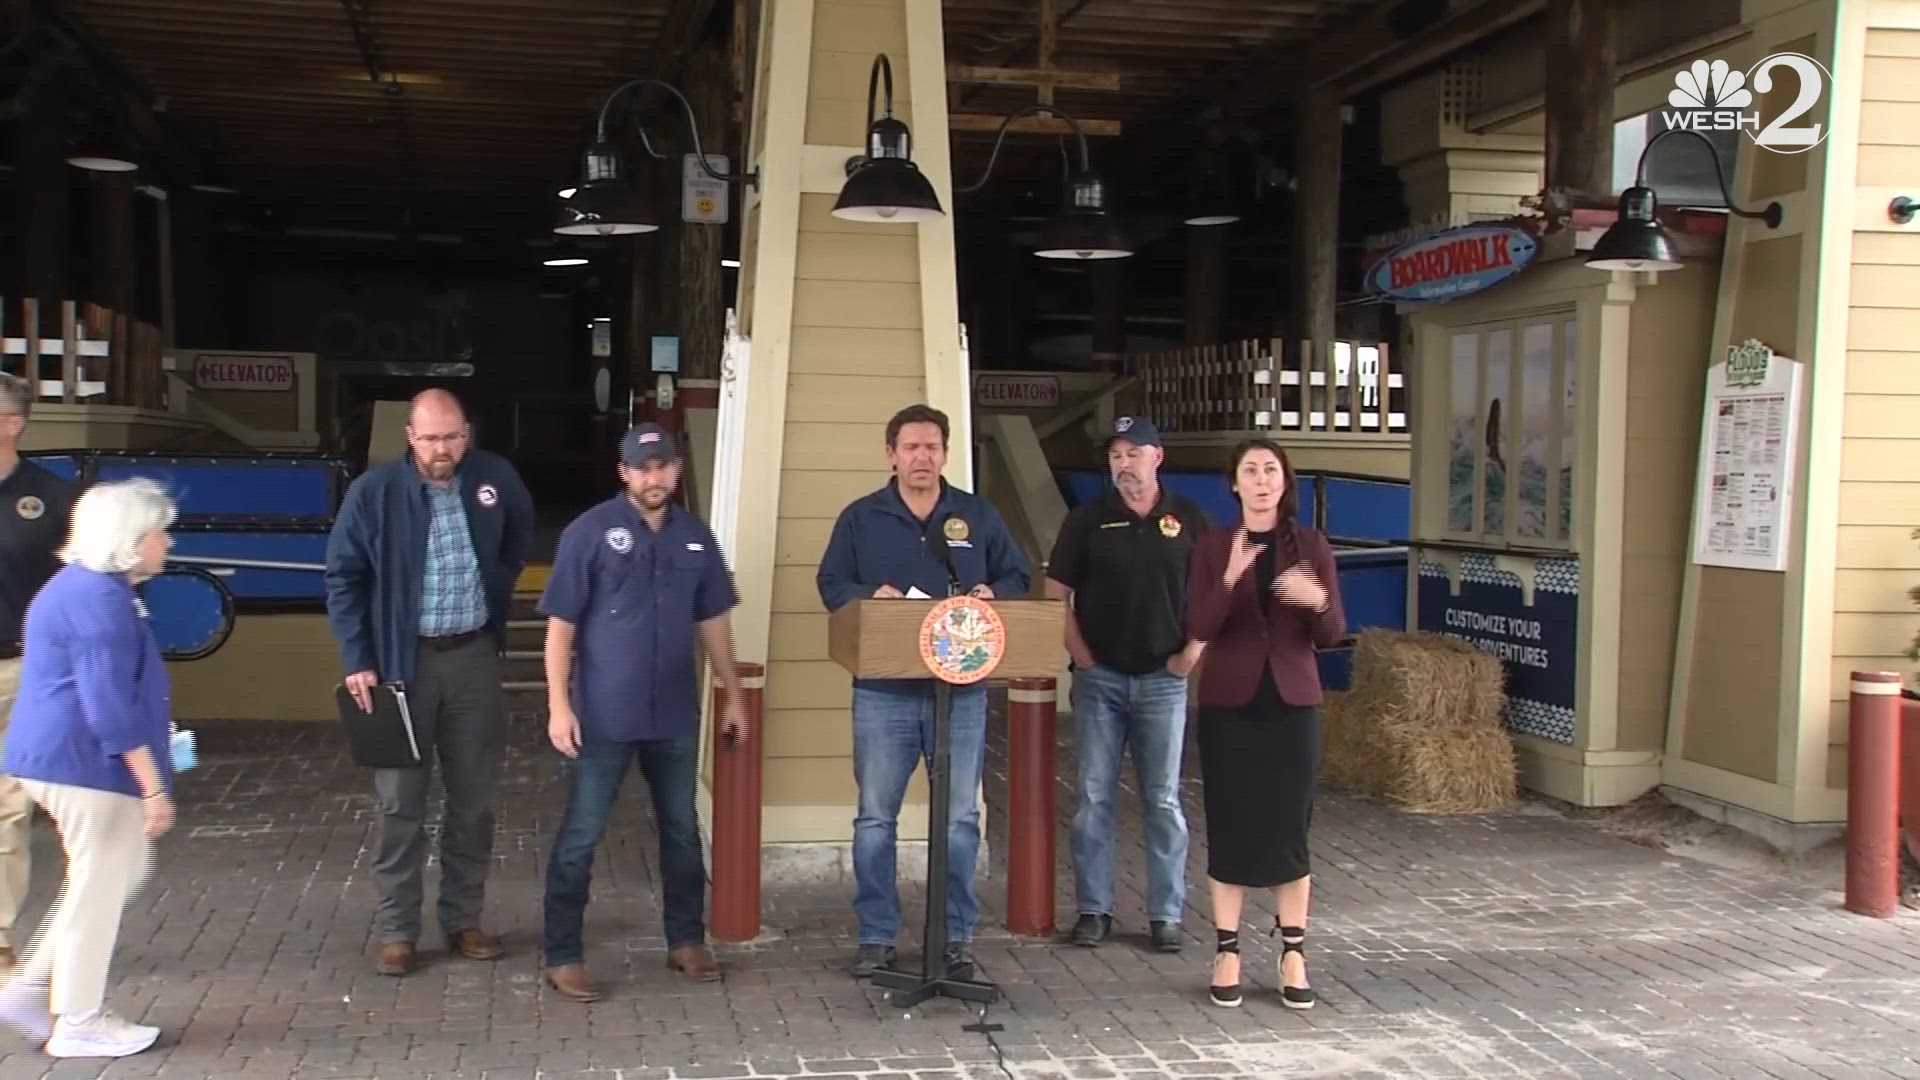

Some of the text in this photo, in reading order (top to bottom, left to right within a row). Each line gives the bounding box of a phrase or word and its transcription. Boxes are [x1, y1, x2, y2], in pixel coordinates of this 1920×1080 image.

[1391, 234, 1512, 289] BOARDWALK
[210, 363, 288, 383] ELEVATOR
[984, 383, 1048, 400] ELEVATOR
[1445, 608, 1541, 640] CUSTOMIZE YOUR
